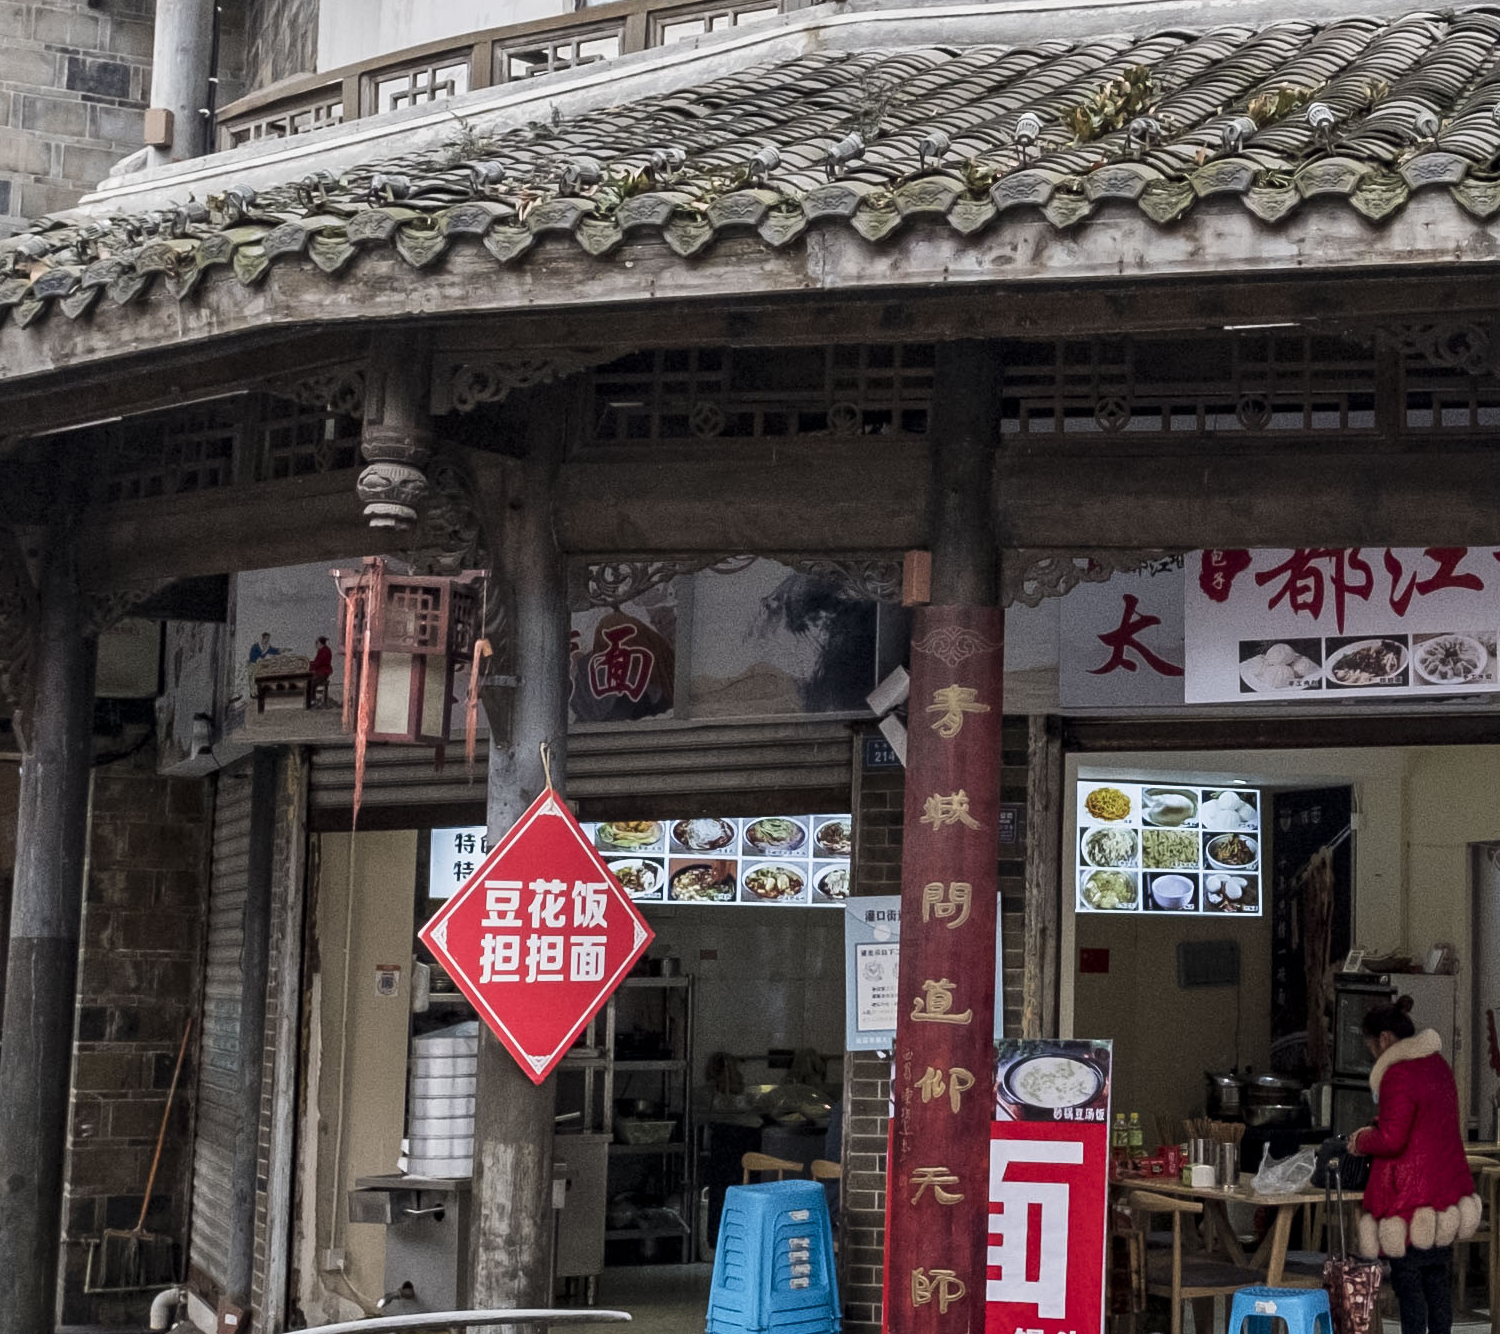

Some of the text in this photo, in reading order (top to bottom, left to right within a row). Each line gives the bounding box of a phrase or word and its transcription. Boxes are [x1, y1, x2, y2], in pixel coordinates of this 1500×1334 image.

[1085, 593, 1185, 677] 太
[454, 833, 488, 855] 特
[480, 878, 609, 929] 豆花饭
[864, 909, 901, 923] 灌口街
[479, 934, 608, 983] 担担面
